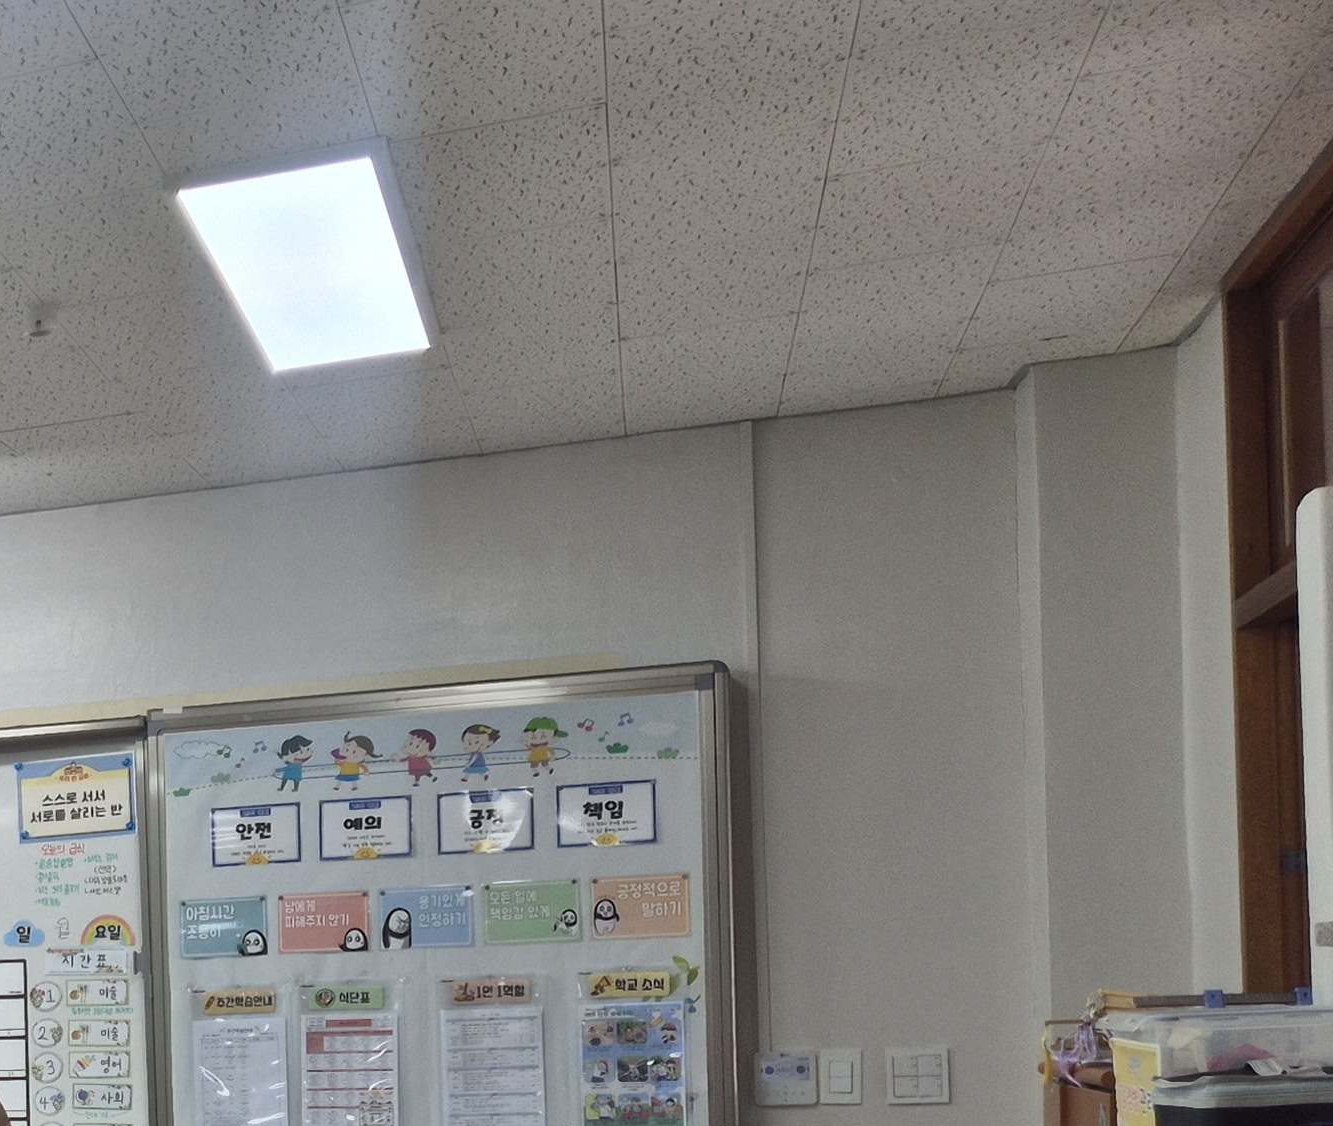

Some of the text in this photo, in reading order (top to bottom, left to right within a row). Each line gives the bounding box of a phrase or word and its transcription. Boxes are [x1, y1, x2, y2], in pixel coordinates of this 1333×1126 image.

[41, 789, 106, 807] 스스로 서서
[30, 803, 123, 824] 서로를 살리는 반
[583, 800, 624, 821] 책임
[343, 815, 383, 831] 예의
[235, 822, 272, 841] 안전
[490, 889, 538, 905] 모든 일에
[617, 881, 681, 900] 긍정적으로
[284, 900, 316, 913] 남에게
[418, 894, 466, 909] 용기있게
[186, 904, 235, 921] 아침시간
[489, 905, 551, 921] 책임감 있게
[641, 901, 682, 918] 말하기
[284, 913, 350, 928] 피해주지 않기
[418, 911, 467, 928] 인정하기
[15, 925, 31, 944] 일
[94, 924, 122, 941] 요일
[62, 954, 107, 969] 시간표
[476, 984, 525, 998] 1인 1역할
[615, 978, 665, 991] 학교 소식
[46, 989, 56, 1003] 1
[98, 987, 118, 1001] 미술
[338, 991, 371, 1005] 식단표
[216, 995, 273, 1009] 주간학습안내
[38, 1026, 49, 1040] 2
[101, 1027, 120, 1041] 미술
[46, 1059, 56, 1075] 3
[100, 1056, 122, 1074] 영어
[39, 1096, 49, 1110] 4
[101, 1092, 124, 1105] 사회
